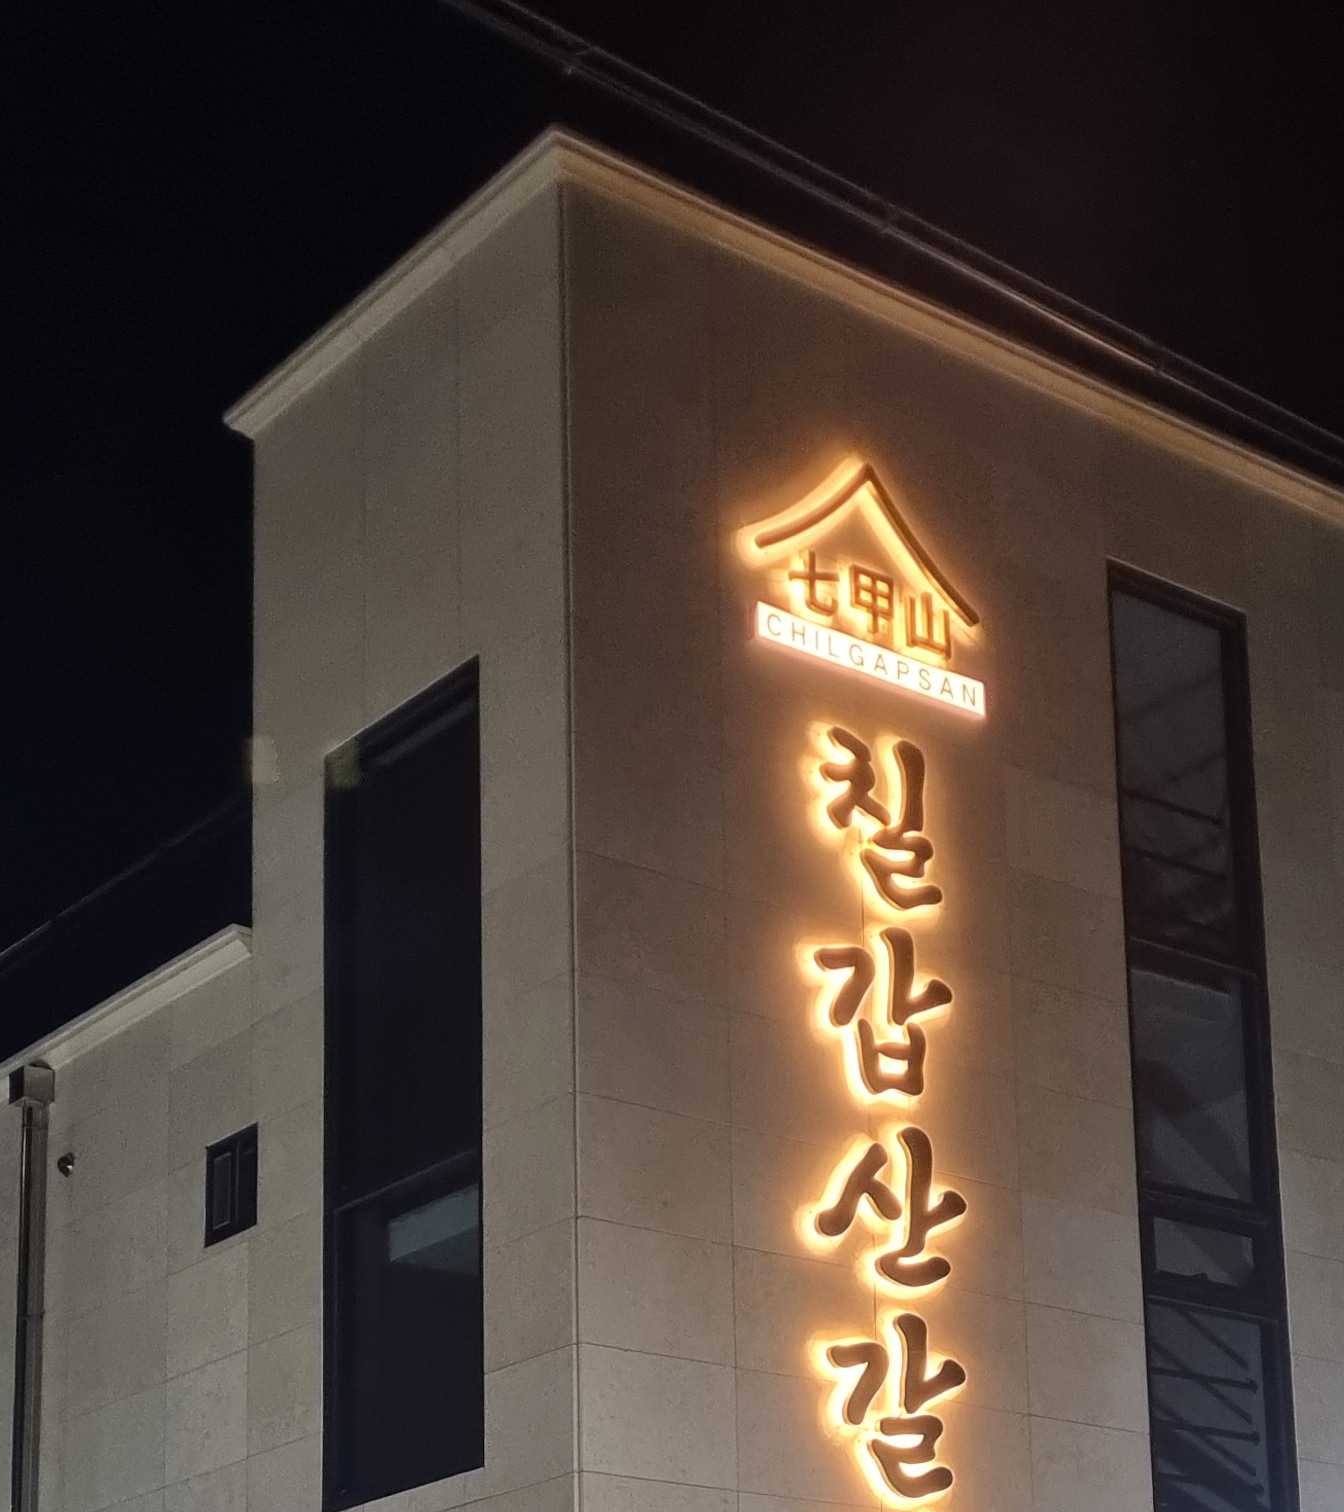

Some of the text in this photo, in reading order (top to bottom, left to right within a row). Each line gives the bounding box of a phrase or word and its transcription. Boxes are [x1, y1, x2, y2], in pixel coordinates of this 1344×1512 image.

[787, 549, 952, 660] 七甲山
[766, 613, 977, 708] CHILGAPSAN
